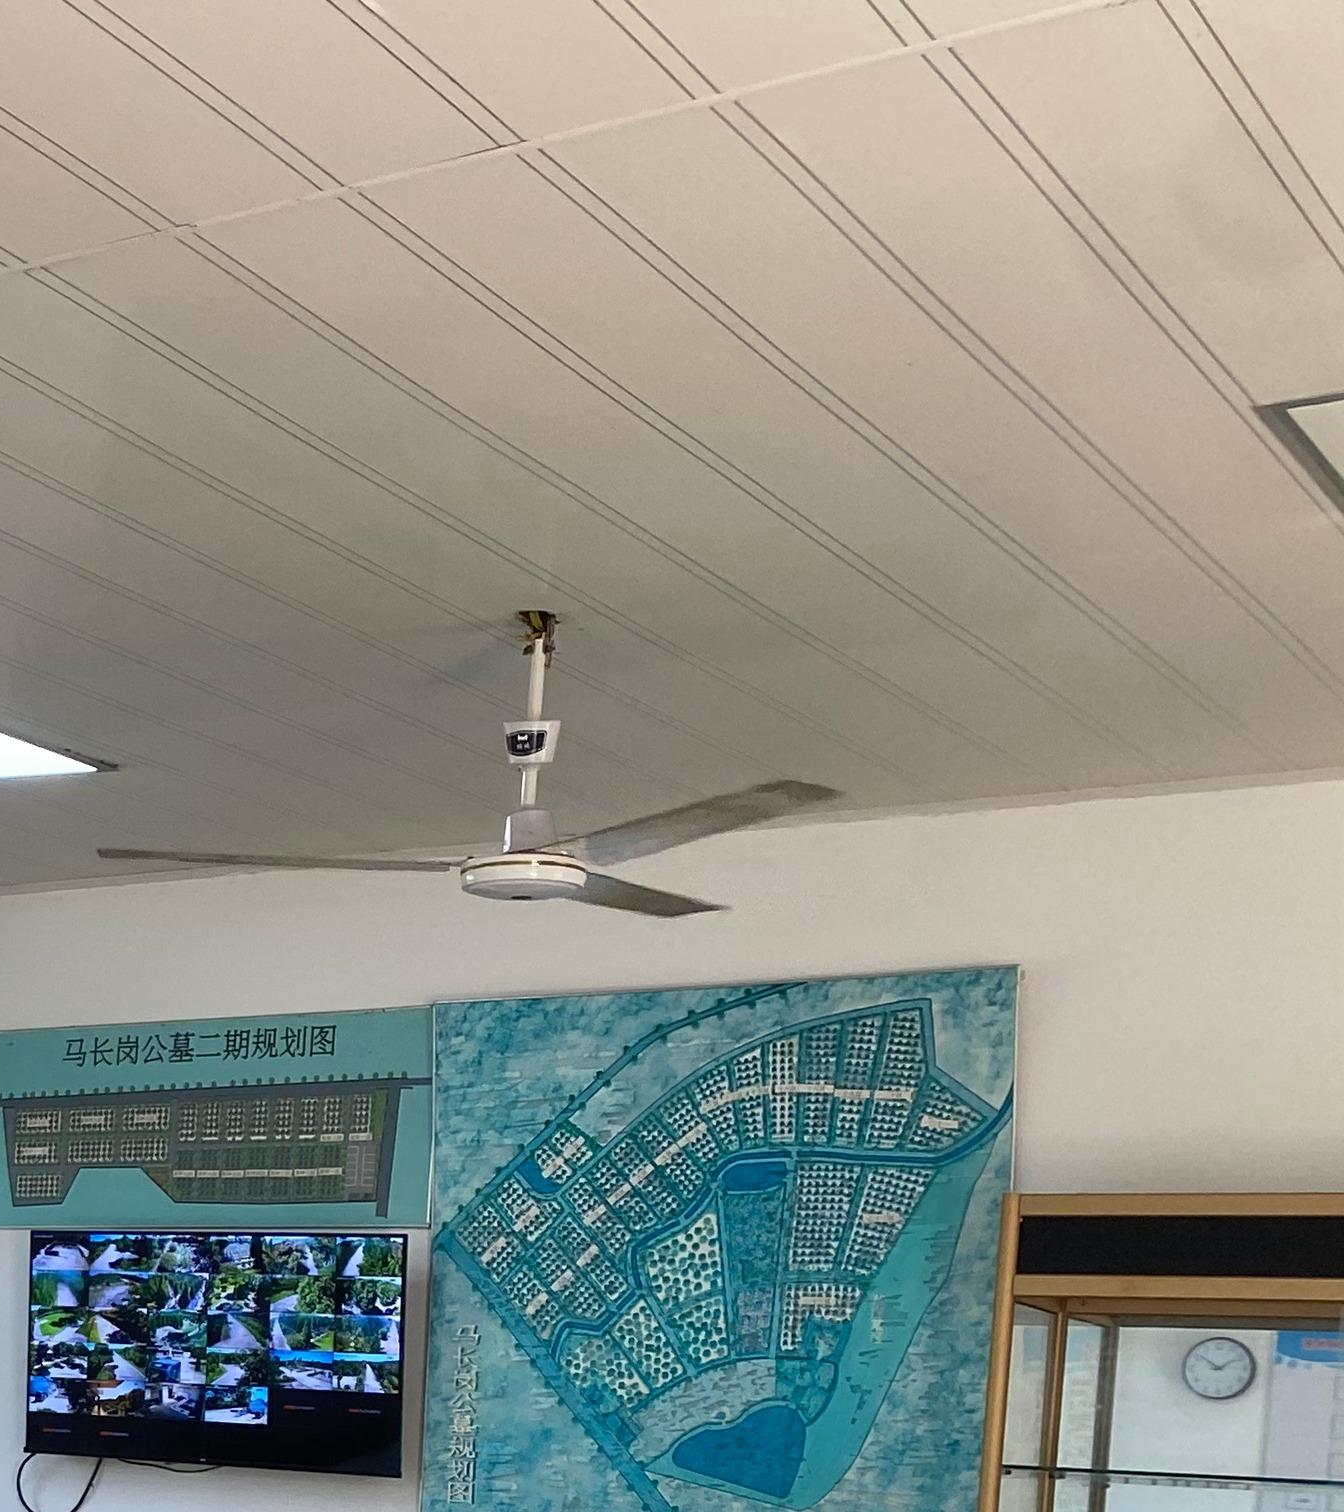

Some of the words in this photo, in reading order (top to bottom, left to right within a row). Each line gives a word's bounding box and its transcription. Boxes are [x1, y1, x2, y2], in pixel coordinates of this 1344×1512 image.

[62, 1025, 337, 1067] 马长岗公墓二期规划图
